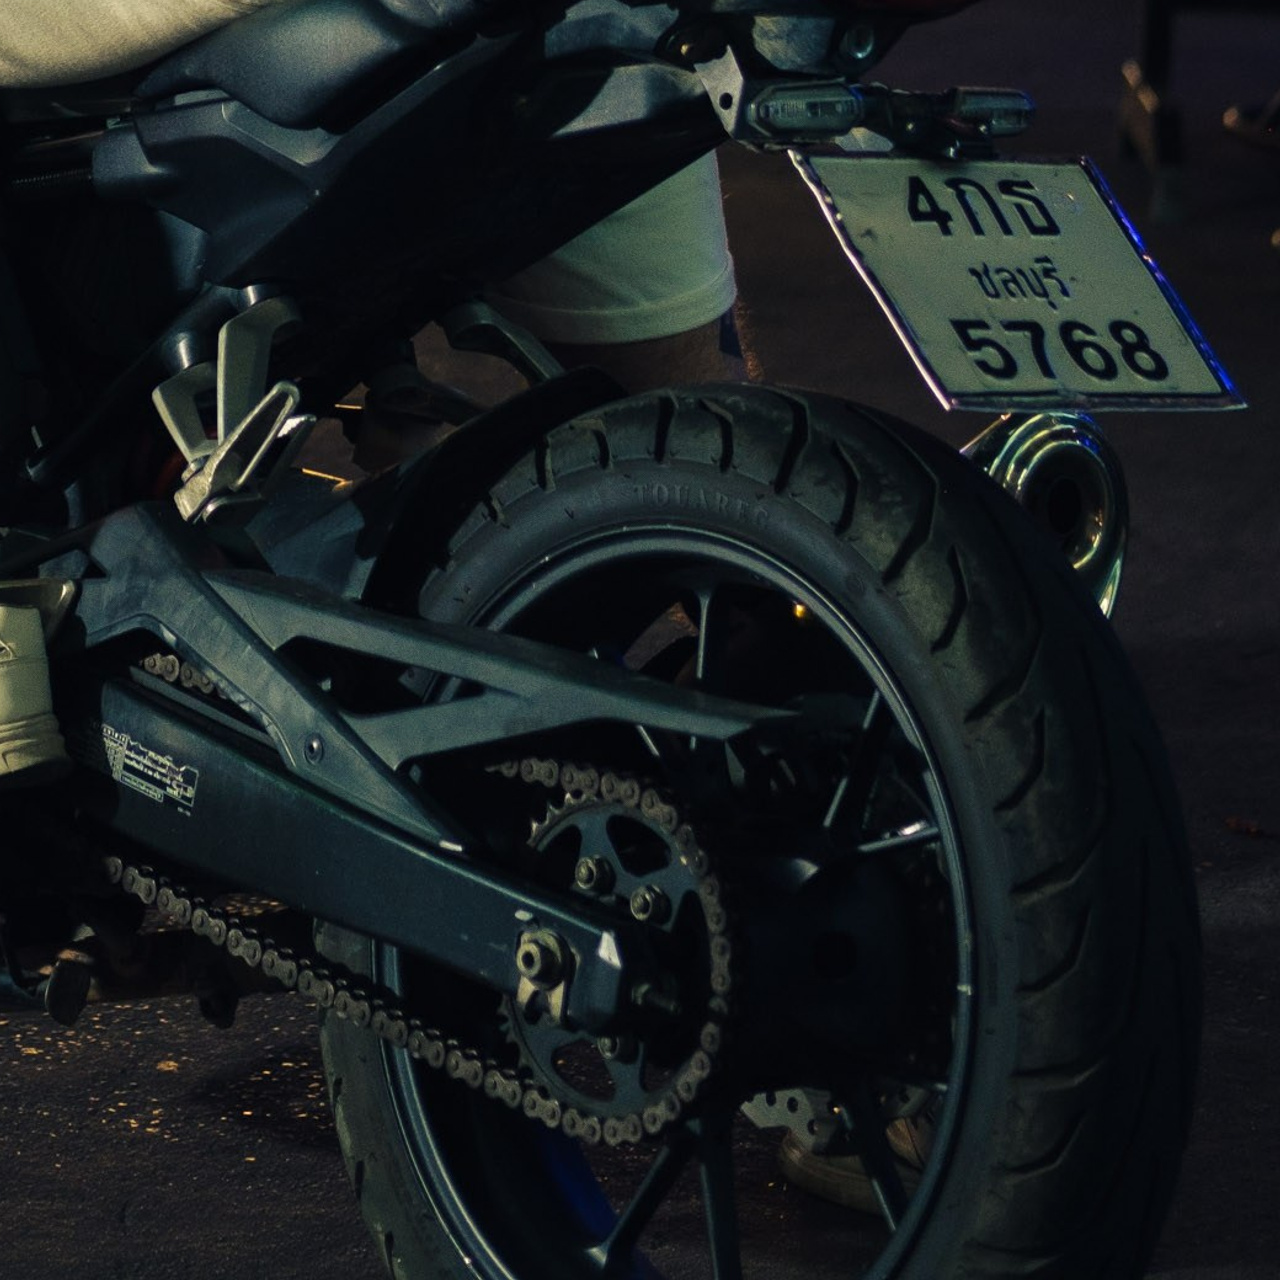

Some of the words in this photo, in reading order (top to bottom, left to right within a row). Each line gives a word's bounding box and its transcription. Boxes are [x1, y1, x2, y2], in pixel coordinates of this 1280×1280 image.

[967, 255, 1071, 310] ชลบุรี
[949, 318, 1169, 382] 5768
